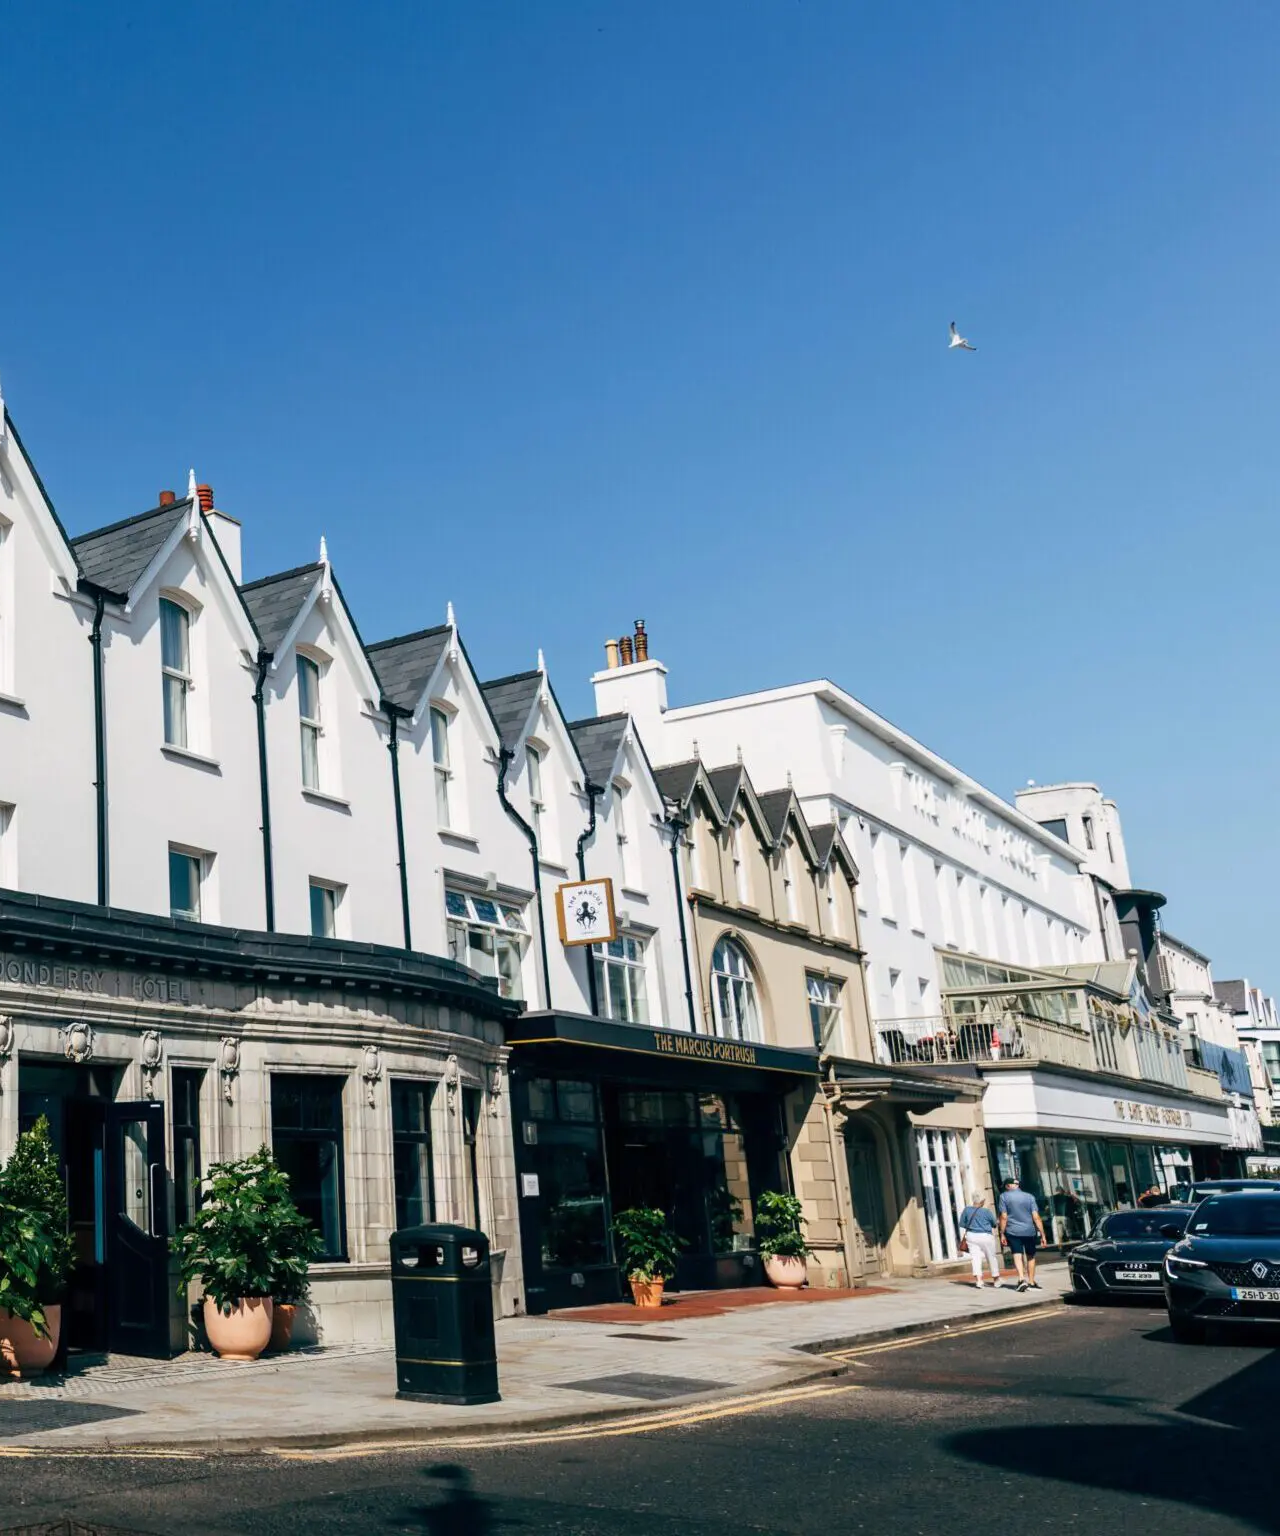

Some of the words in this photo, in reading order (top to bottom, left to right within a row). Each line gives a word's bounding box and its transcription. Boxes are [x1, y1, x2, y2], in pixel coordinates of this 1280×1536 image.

[131, 975, 191, 1003] HOTEL
[654, 1032, 674, 1052] THE
[675, 1036, 712, 1058] MARCUS
[713, 1042, 756, 1064] PORTRUSH
